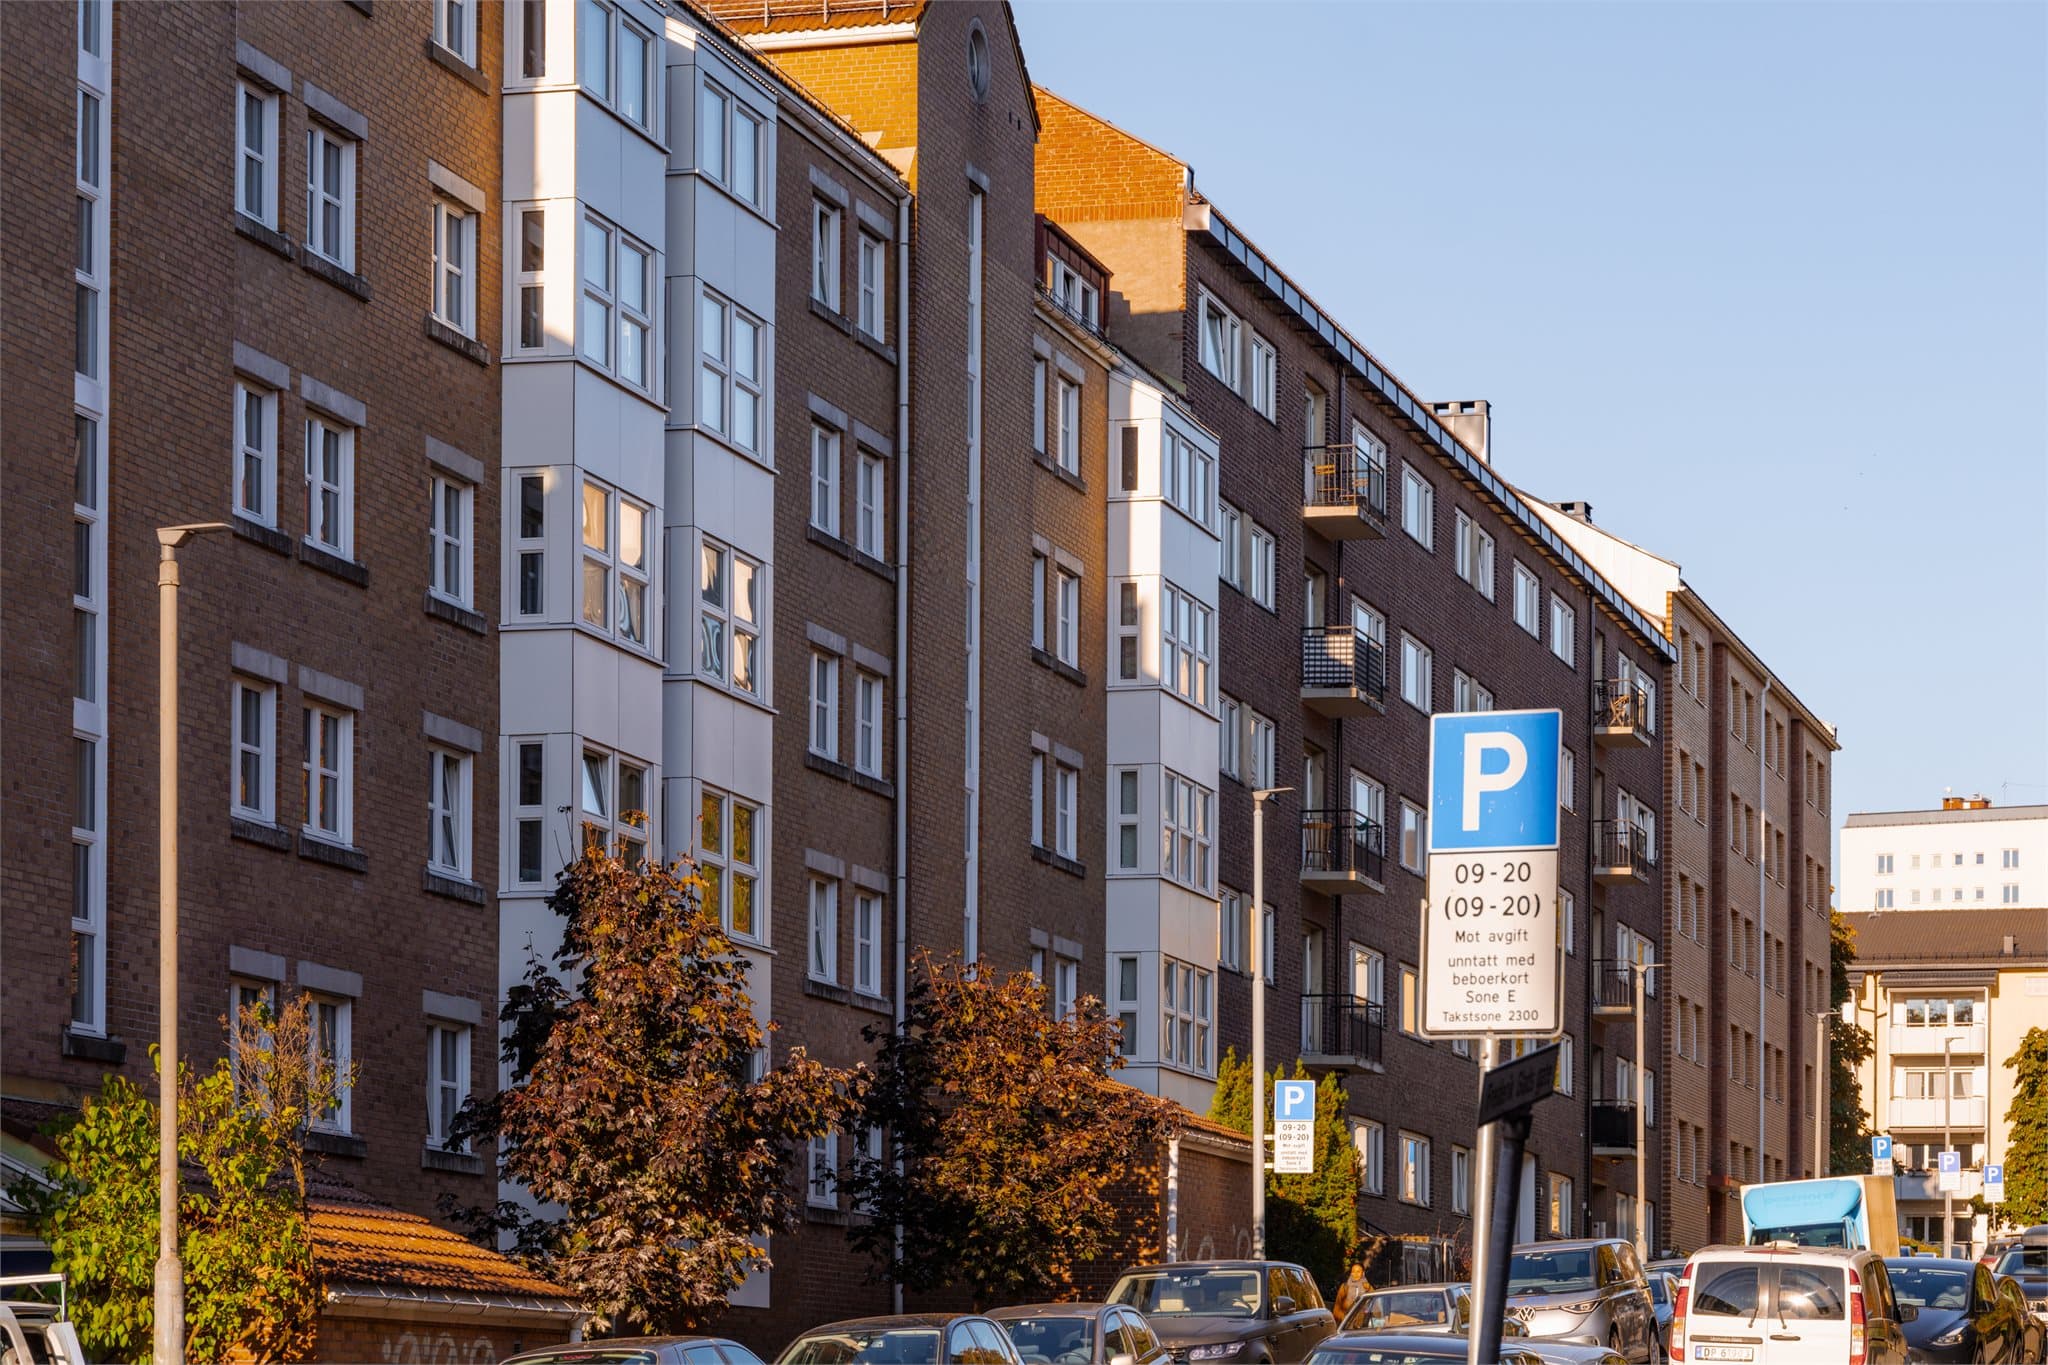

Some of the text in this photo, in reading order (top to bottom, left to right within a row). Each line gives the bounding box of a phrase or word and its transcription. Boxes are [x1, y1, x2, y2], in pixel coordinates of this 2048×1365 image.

[1462, 731, 1528, 832] P
[1455, 928, 1529, 945] Mot avgift
[1448, 953, 1535, 968] unntatt med
[1452, 972, 1529, 986] beboerkort
[1466, 989, 1516, 1004] Sone E
[1443, 1009, 1539, 1023] Takstsone 2300
[1284, 1086, 1305, 1116] P
[1876, 1139, 1888, 1157] P
[1943, 1154, 1955, 1171] P
[1987, 1167, 1999, 1182] P
